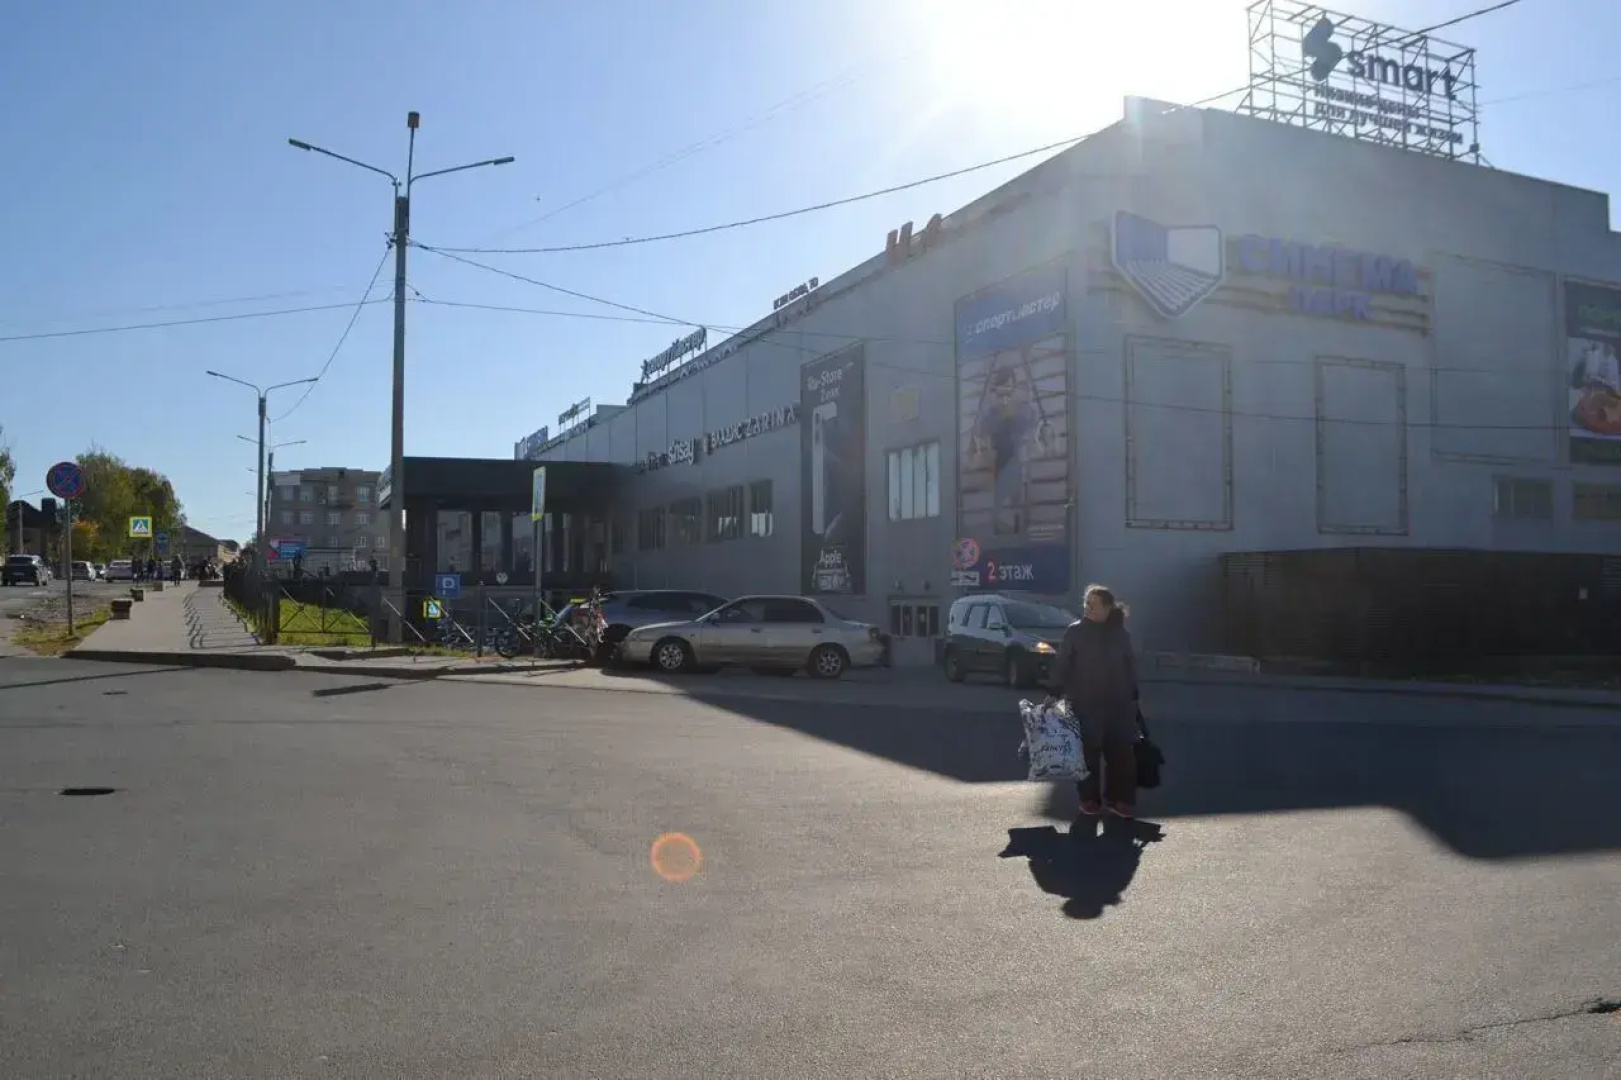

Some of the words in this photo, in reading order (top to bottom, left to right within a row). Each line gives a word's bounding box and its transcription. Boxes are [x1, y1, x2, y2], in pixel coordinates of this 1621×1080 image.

[1347, 51, 1457, 101] smart
[987, 561, 997, 580] 2
[999, 564, 1034, 580] этаж
